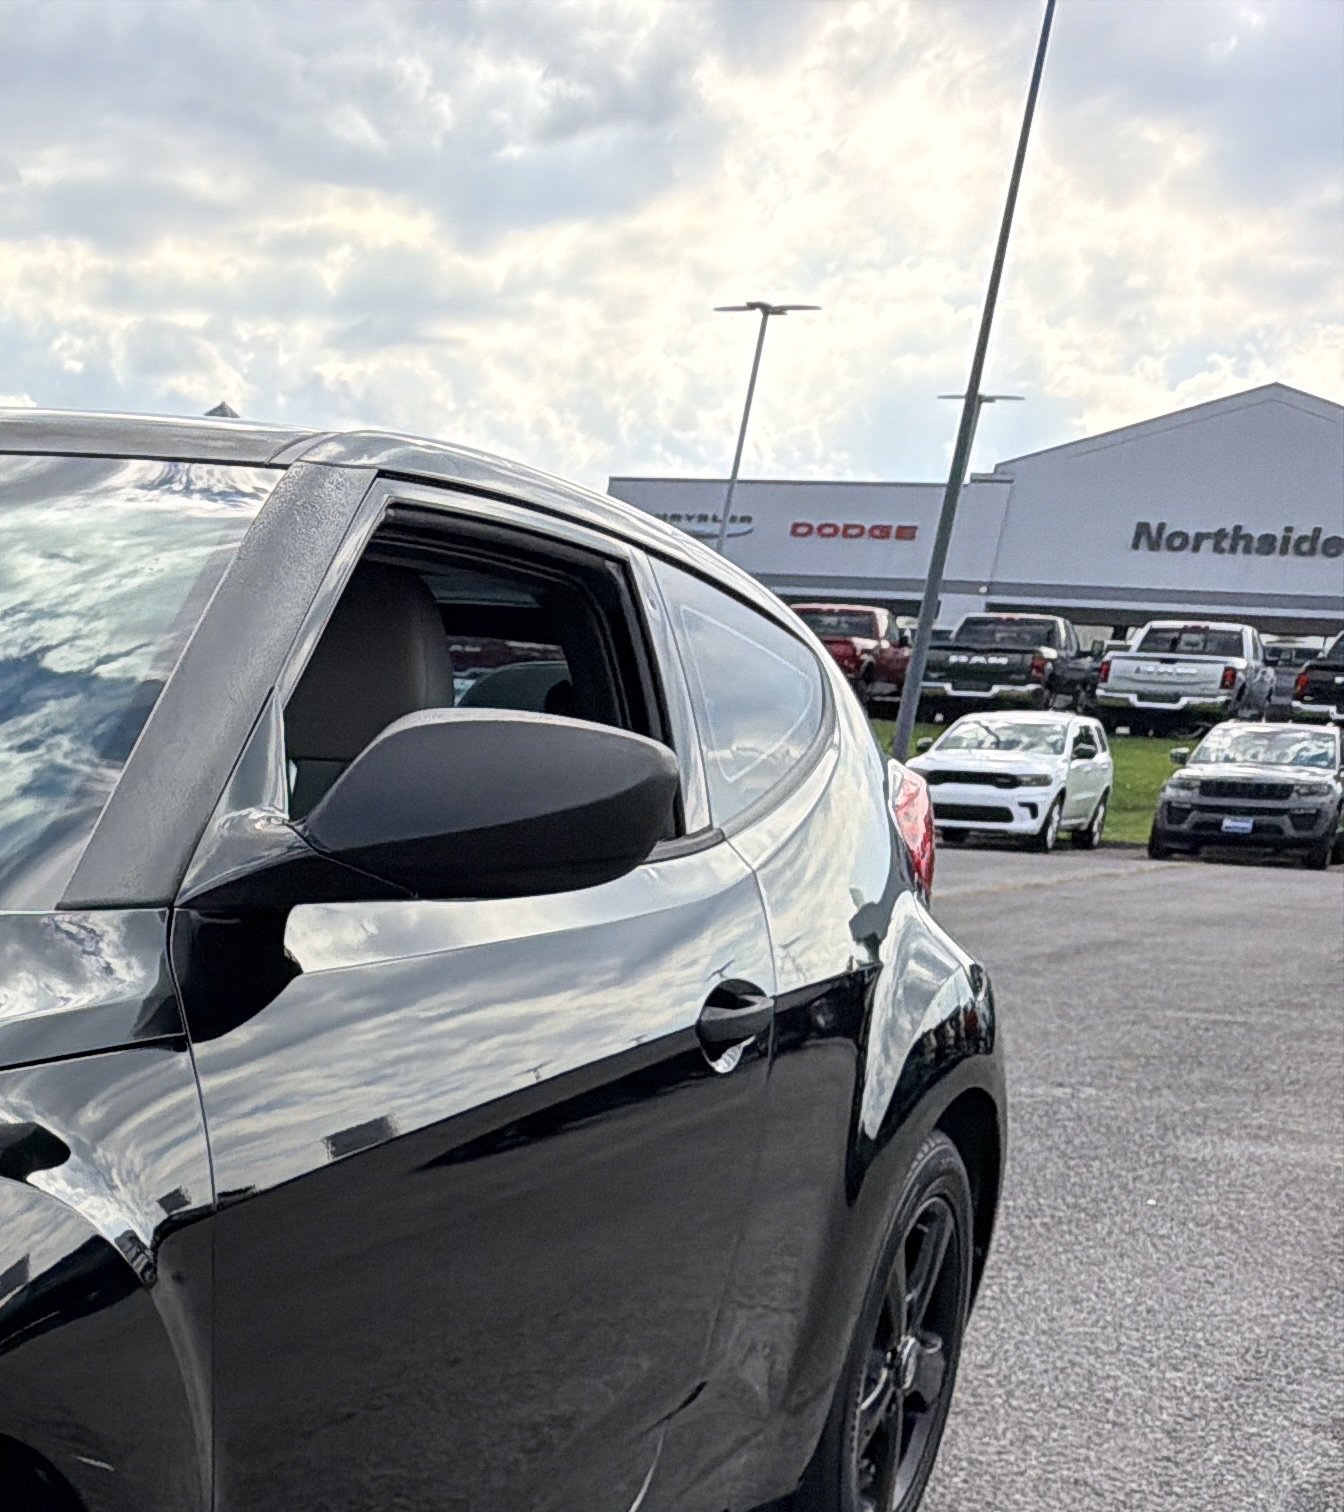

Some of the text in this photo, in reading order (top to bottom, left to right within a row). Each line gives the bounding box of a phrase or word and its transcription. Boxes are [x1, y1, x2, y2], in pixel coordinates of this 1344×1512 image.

[790, 522, 918, 541] DODGE
[1131, 521, 1344, 558] Northside
[949, 654, 1009, 665] RAM
